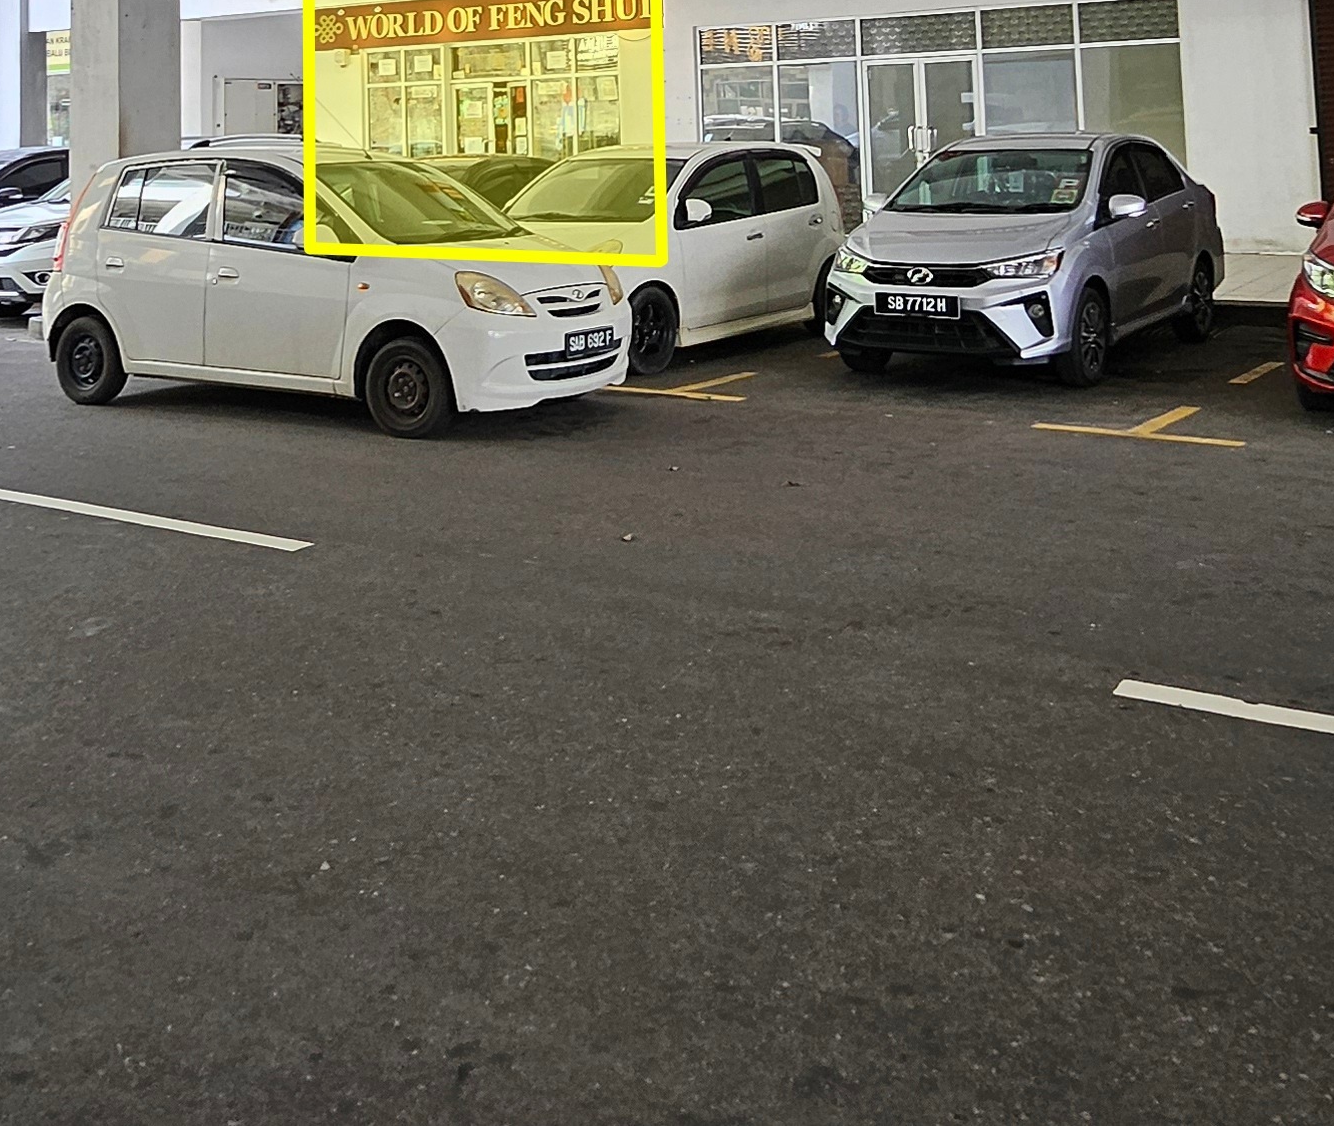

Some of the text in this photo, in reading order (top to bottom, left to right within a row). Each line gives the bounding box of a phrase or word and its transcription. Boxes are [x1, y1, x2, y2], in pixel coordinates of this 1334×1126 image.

[346, 10, 444, 41] WORLD
[446, 4, 483, 34] OF
[887, 295, 947, 312] SB 7712 H
[587, 331, 605, 349] 692
[606, 329, 613, 346] F
